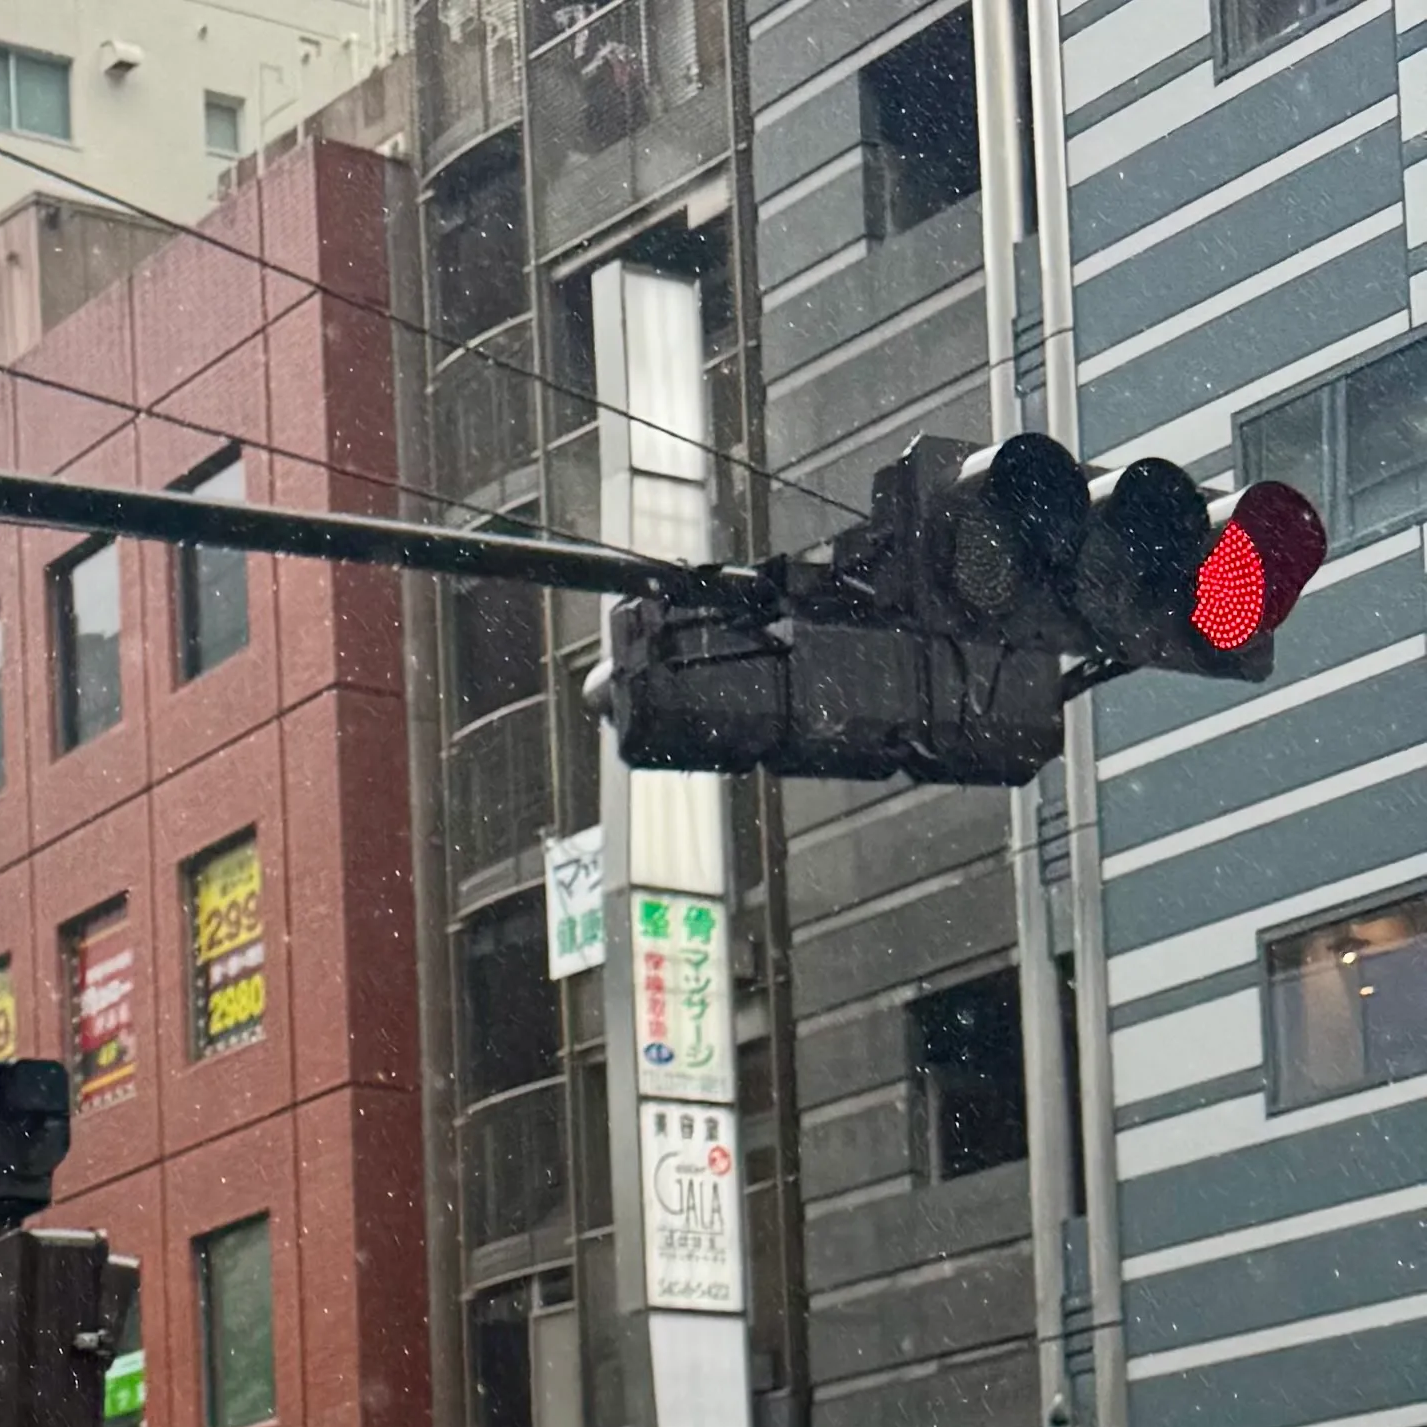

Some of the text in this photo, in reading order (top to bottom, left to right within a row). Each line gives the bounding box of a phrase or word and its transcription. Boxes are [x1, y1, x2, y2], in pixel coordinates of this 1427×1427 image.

[681, 949, 715, 1069] マッサージ
